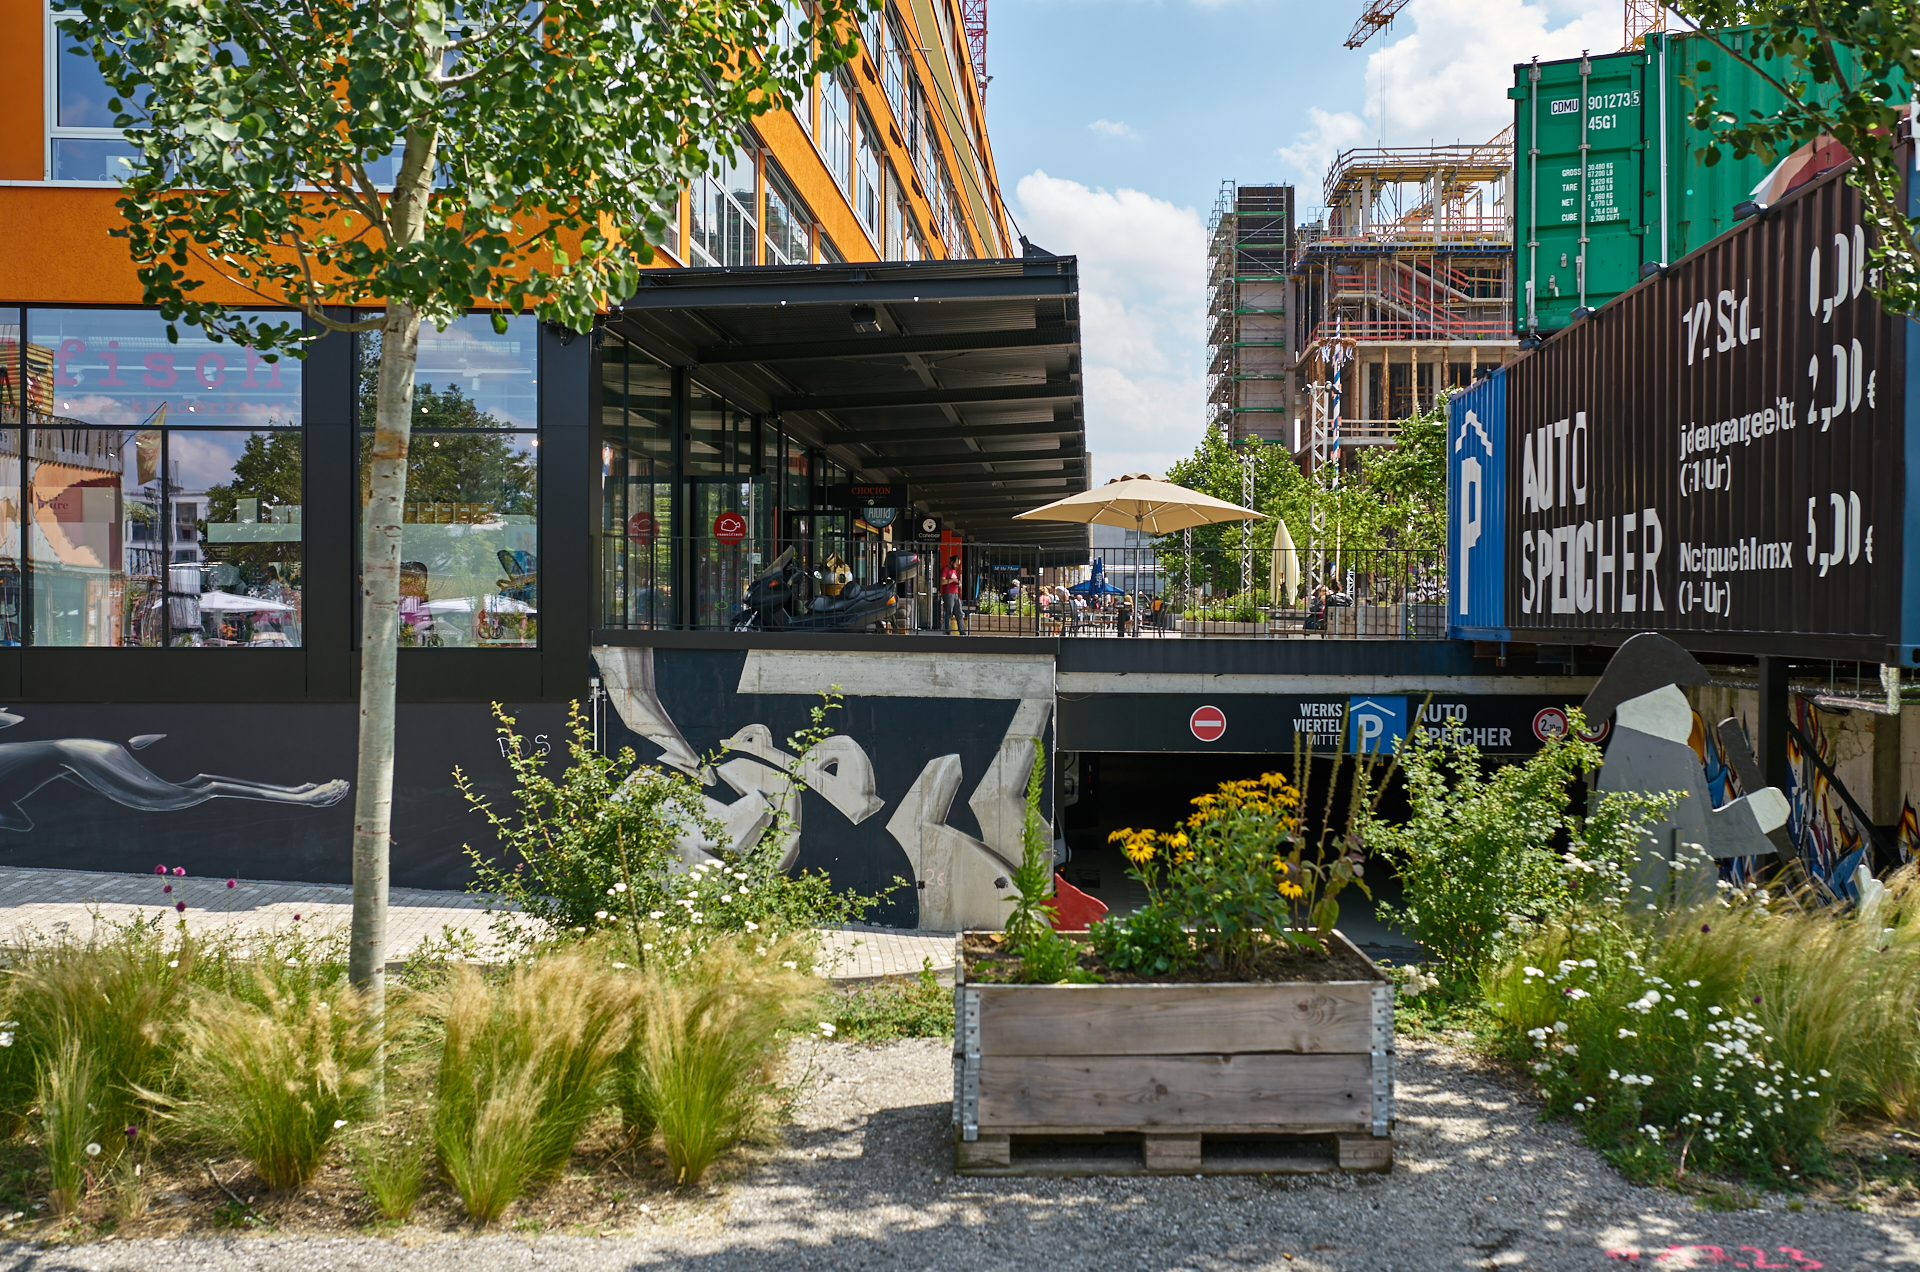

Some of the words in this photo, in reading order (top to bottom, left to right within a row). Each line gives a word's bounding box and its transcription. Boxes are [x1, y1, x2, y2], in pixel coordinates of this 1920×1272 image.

[1552, 99, 1579, 114] CDMU
[1588, 114, 1617, 130] 45G1
[1562, 168, 1582, 177] GROSS
[1562, 183, 1578, 191] TARE
[1562, 198, 1574, 206] NET
[1562, 213, 1578, 221] CUBE
[1523, 411, 1588, 515] AUTO
[851, 486, 892, 495] CHOCION
[1522, 508, 1664, 614] SPEICHER
[1300, 703, 1342, 717] WERKS
[1414, 704, 1467, 723] AUTO
[1293, 719, 1342, 732] VIERTEL
[1414, 727, 1512, 746] SPECHER
